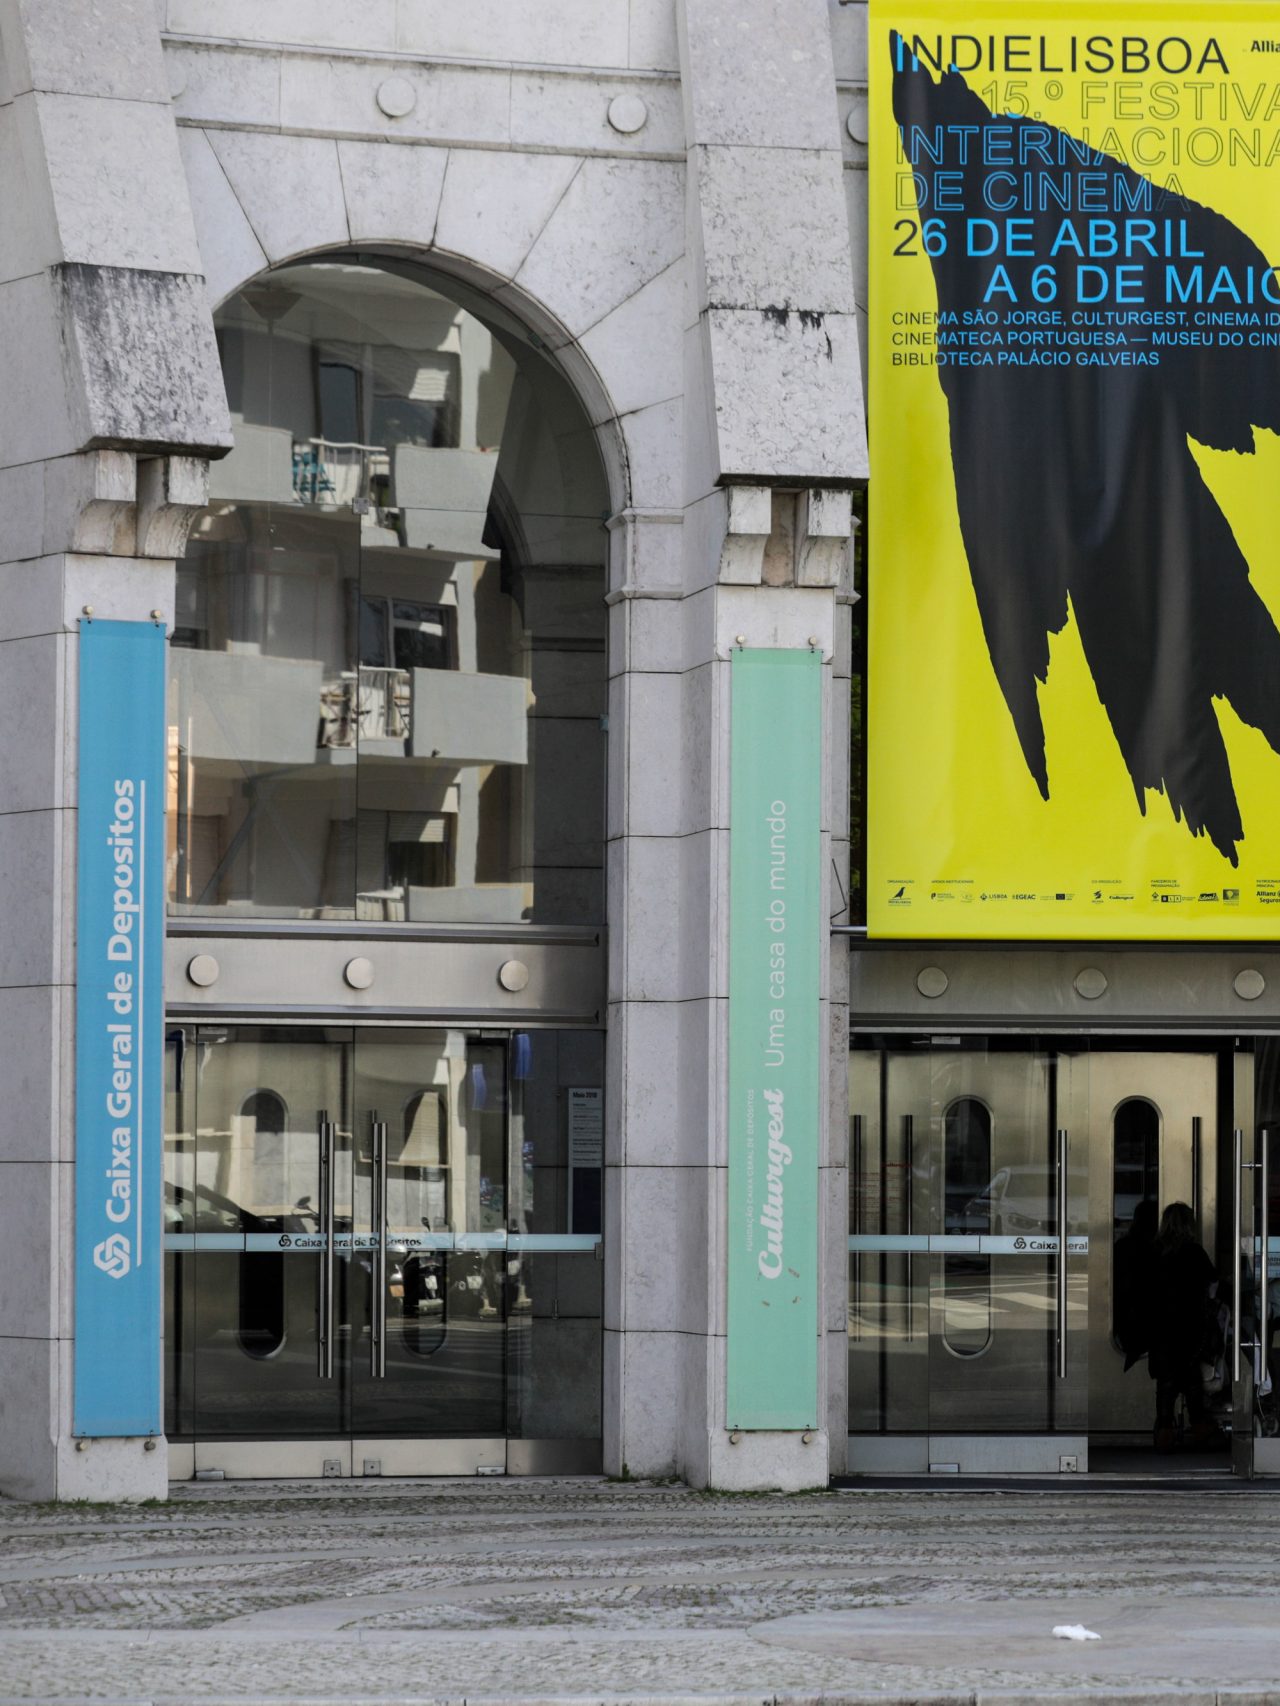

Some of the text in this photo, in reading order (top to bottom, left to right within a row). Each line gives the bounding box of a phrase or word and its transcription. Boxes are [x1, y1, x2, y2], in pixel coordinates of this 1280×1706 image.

[896, 34, 1230, 74] INDIELISBOA
[895, 171, 1190, 212] DE CINEMA
[892, 218, 1205, 258] 26 DE ABRIL
[983, 265, 1018, 303] A
[1031, 265, 1057, 304] 6
[1077, 265, 1145, 304] DE
[892, 311, 958, 326] CINEMA
[963, 308, 1000, 326] SÃO
[1003, 311, 1066, 328] JORGE,
[1072, 311, 1188, 328] CULTURGEST,
[1199, 312, 1260, 327] CINEMA
[892, 331, 1004, 346] CINEMATECA
[1007, 332, 1127, 346] PORTUGUESA
[1152, 332, 1214, 346] MUSEU
[1219, 332, 1244, 347] DO
[892, 350, 1160, 366] BIBLIOTECA PALÁCIO GALVEIAS
[764, 800, 787, 1068] Uma casa do mundo
[106, 973, 133, 1016] de
[106, 1024, 132, 1118] Geral
[105, 1126, 132, 1223] Caixa
[745, 1150, 754, 1177] GERAL
[745, 1178, 754, 1203] CAIXA
[757, 1089, 793, 1280] Culturgest
[294, 1238, 322, 1247] Caixa
[744, 1205, 755, 1252] FUNDAÇÃO
[1029, 1241, 1088, 1250] Caixa eral
